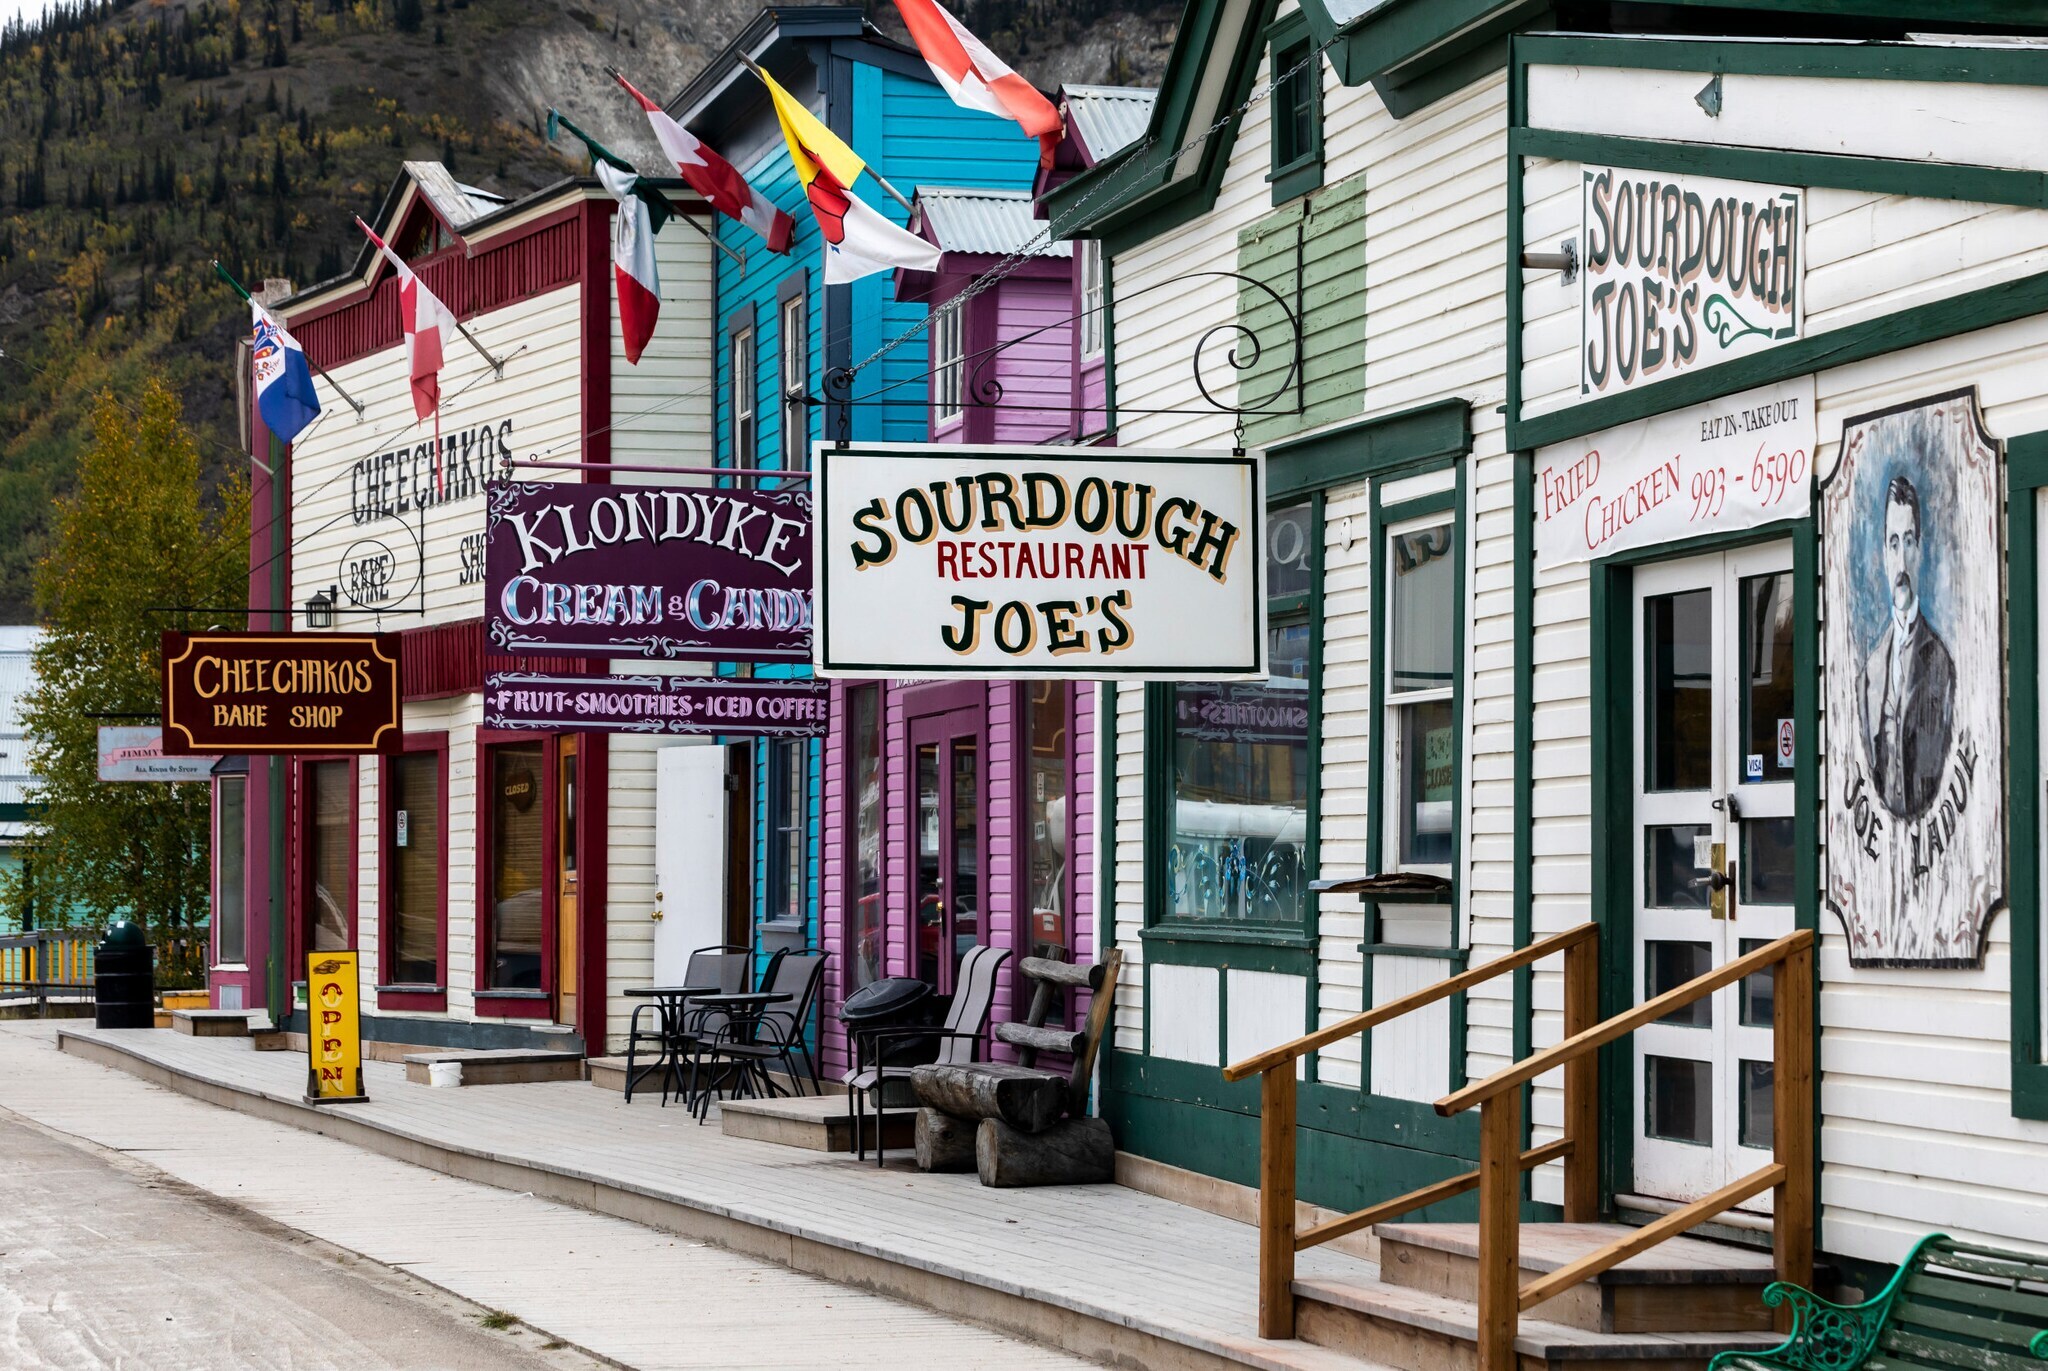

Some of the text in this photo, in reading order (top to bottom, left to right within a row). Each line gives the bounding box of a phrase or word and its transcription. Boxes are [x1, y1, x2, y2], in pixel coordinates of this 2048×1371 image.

[1587, 168, 1795, 314] SOURDOUGH
[1587, 276, 1700, 392] JOE'S
[1701, 418, 1722, 442] EAT
[1724, 414, 1737, 436] IN
[1542, 450, 1600, 522] FRIED
[1585, 454, 1681, 551] CHICKEN
[1690, 467, 1725, 523] 993
[1752, 441, 1806, 507] 6590
[502, 489, 807, 578] KLONDYKE
[850, 471, 1240, 585] SOURDOUGH
[350, 554, 389, 606] BAKE
[937, 541, 1150, 582] RESTAURANT
[500, 574, 664, 627] CREAM
[685, 579, 813, 634] CANDY
[941, 589, 1135, 657] JOE'S
[194, 655, 373, 699] CHEECHAKOS
[213, 704, 343, 728] BAKE SHOP
[756, 697, 827, 720] COFFEE
[505, 782, 530, 797] CLOSED
[1424, 764, 1453, 790] CLOSE
[1748, 759, 1762, 772] VISA
[1843, 761, 1883, 863] JOE
[318, 982, 344, 1093] OPEN
